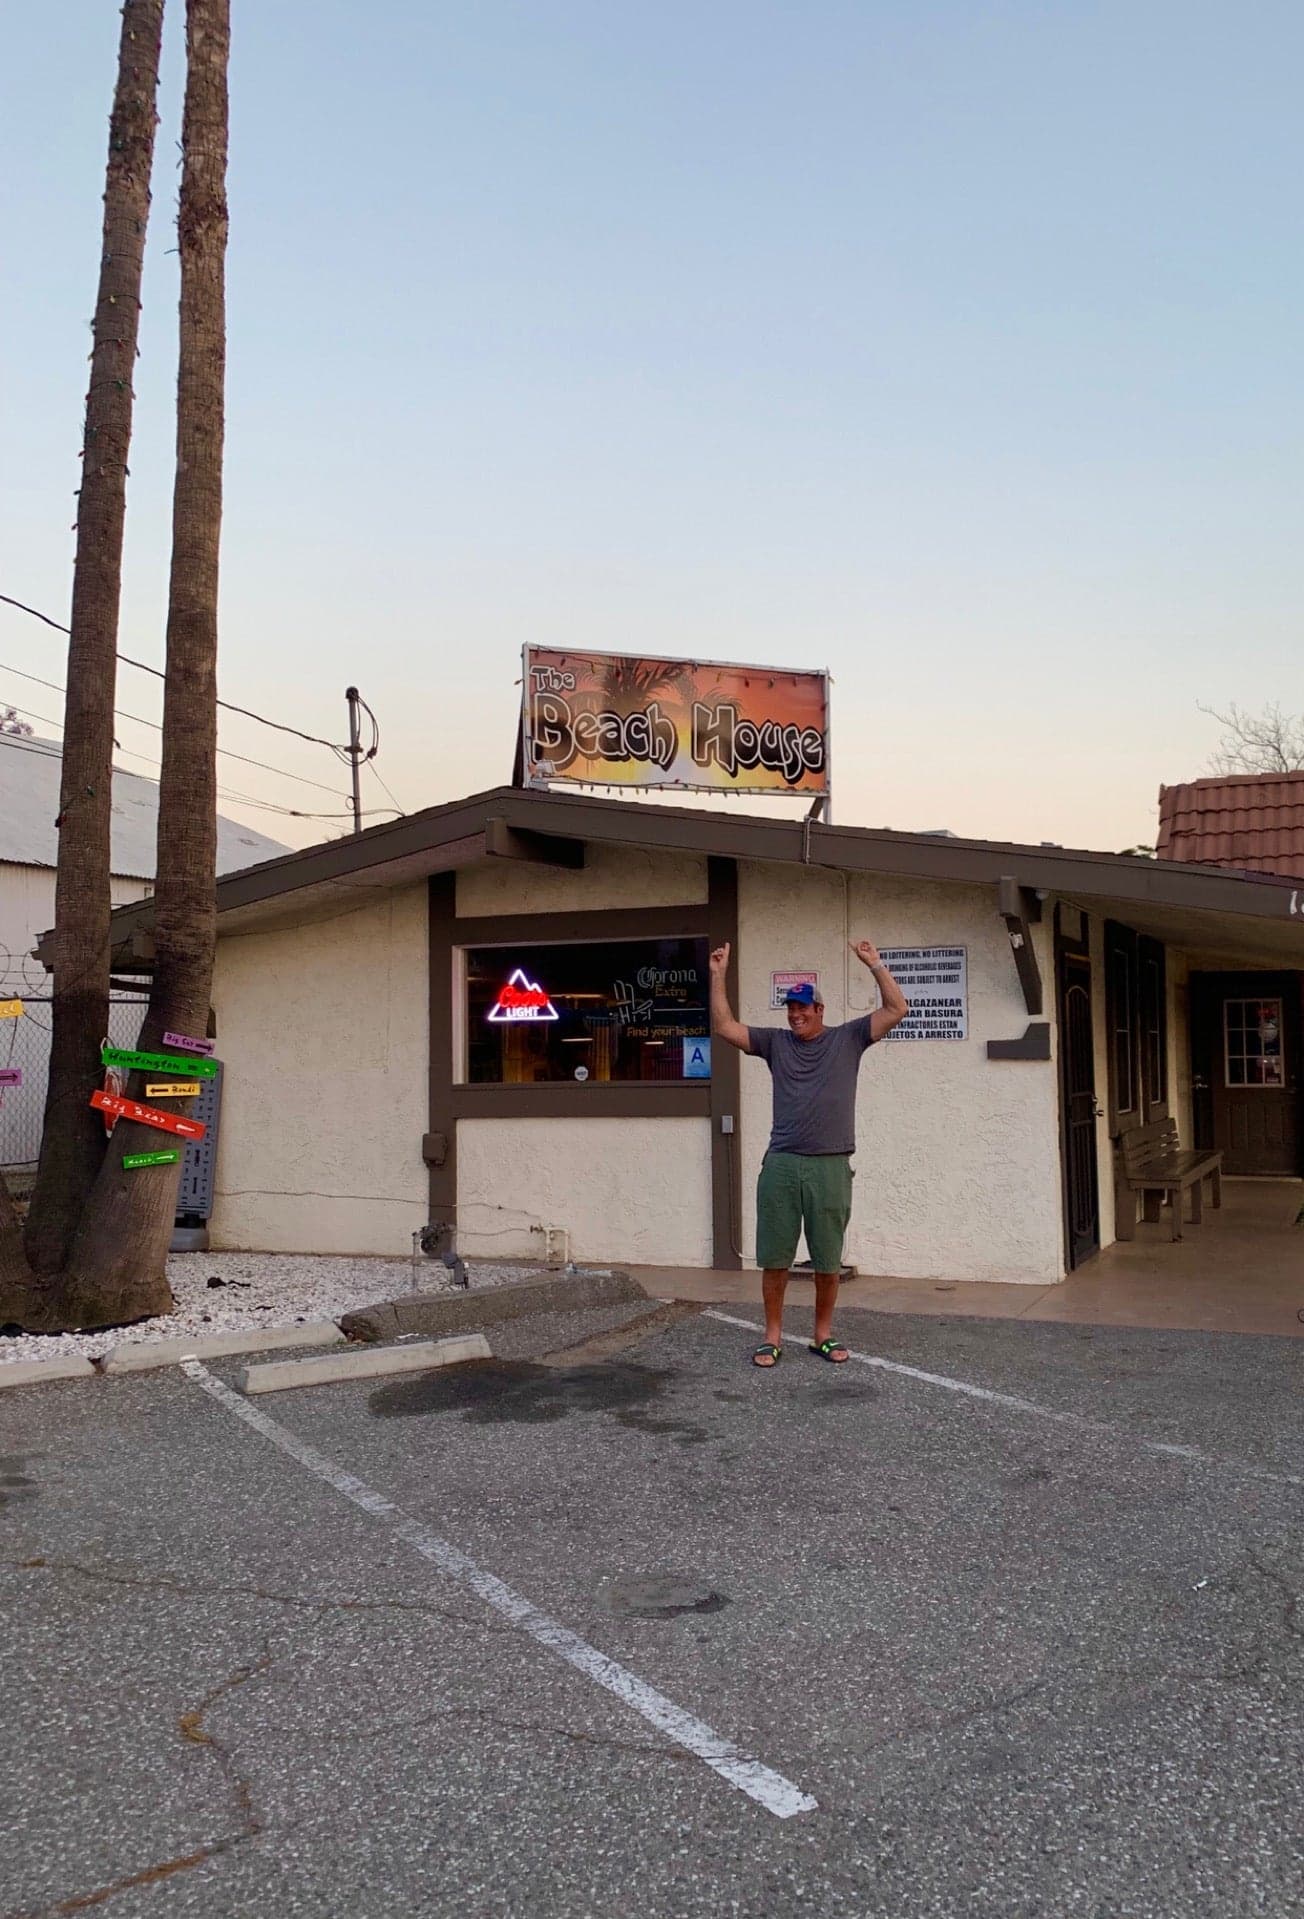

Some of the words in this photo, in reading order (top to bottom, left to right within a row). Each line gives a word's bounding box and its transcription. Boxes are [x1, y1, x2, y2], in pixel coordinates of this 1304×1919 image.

[530, 665, 576, 692] The
[533, 693, 678, 771] Beach
[691, 702, 824, 783] House
[923, 950, 931, 958] NO
[637, 967, 698, 989] Corona
[774, 974, 815, 984] WARNING
[655, 985, 688, 997] Extra
[506, 1006, 540, 1017] LIGHT
[924, 1009, 963, 1017] BASURA
[939, 1020, 958, 1029] ESTAN
[627, 1027, 649, 1037] Find
[650, 1027, 675, 1039] your
[676, 1026, 706, 1036] beach
[918, 1031, 924, 1039] A
[925, 1030, 963, 1039] ARRESTO
[166, 1033, 179, 1045] Big
[108, 1052, 181, 1070] Huntington
[691, 1047, 705, 1063] A
[101, 1096, 125, 1114] Big
[134, 1106, 166, 1123] Bear
